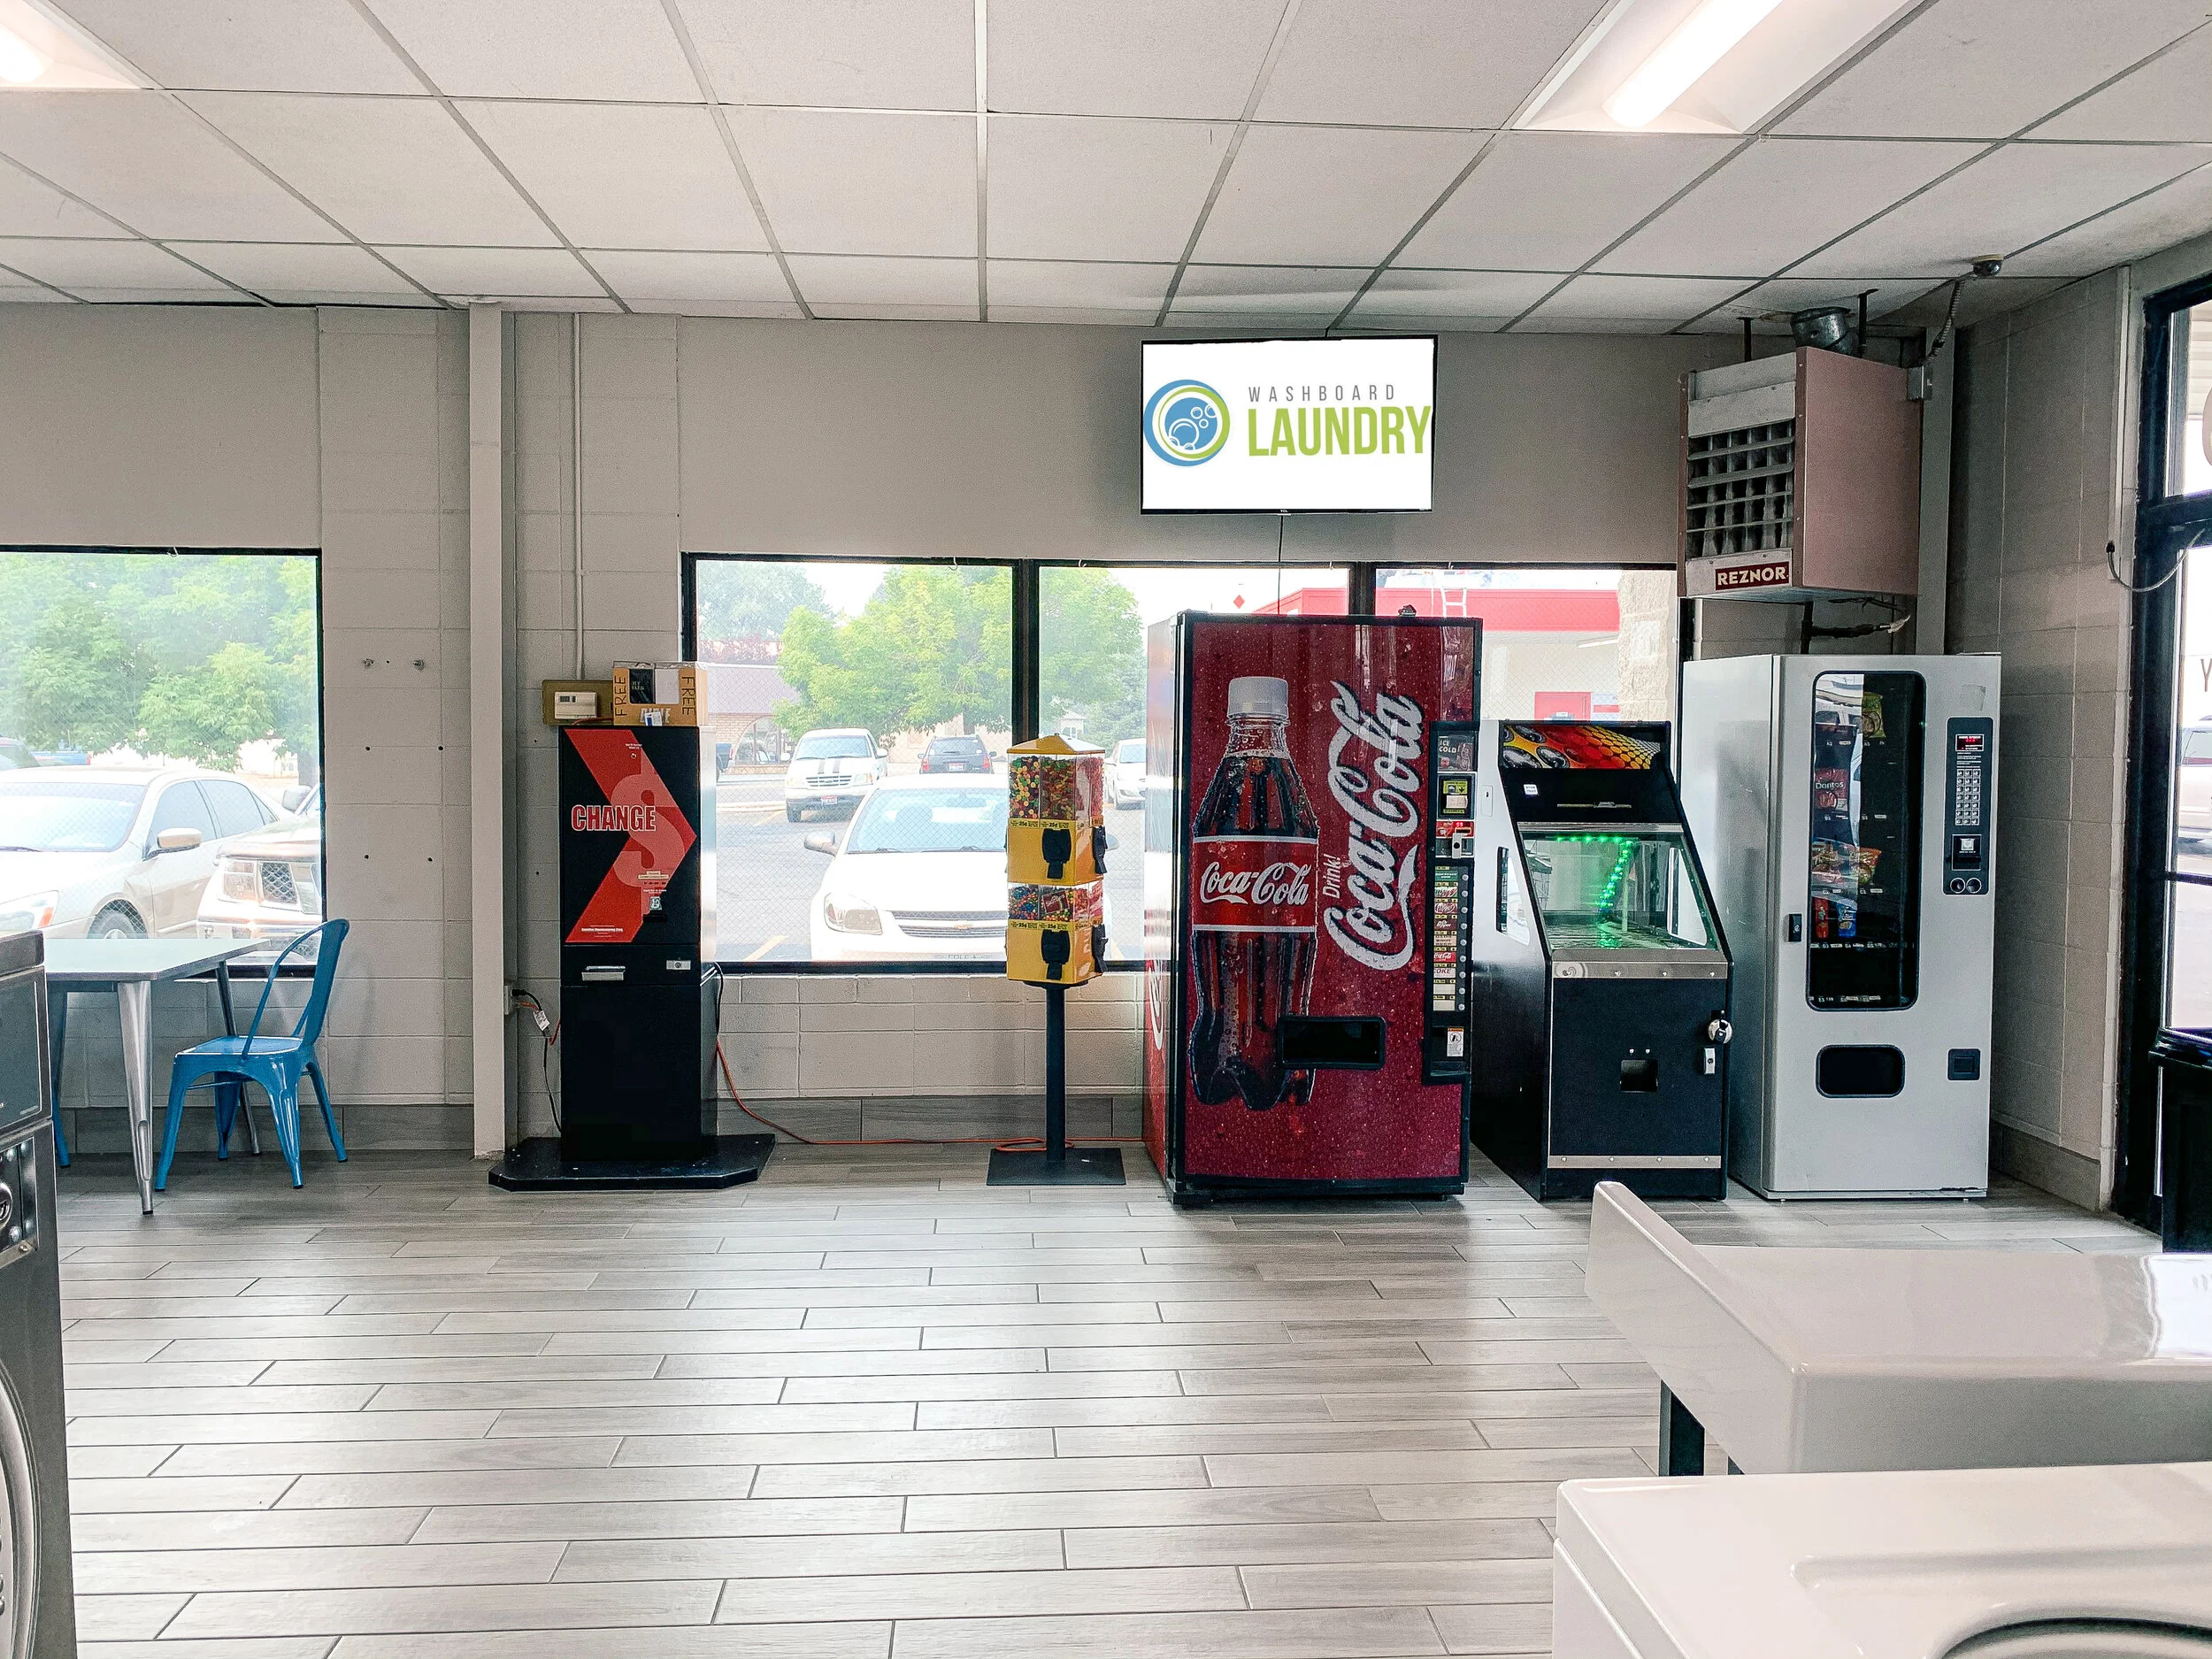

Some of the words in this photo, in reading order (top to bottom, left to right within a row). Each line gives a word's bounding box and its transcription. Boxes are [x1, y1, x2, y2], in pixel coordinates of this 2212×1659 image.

[1248, 384, 1394, 403] WASHBOARD
[1248, 405, 1432, 457] LAUNDRY
[1717, 566, 1787, 586] REZNOR
[614, 675, 627, 717] FREE
[681, 676, 696, 715] FREE
[571, 804, 657, 832] CHANGE
[1324, 680, 1425, 971] Coca-Cola
[1200, 860, 1310, 906] Coca-Cola
[1322, 853, 1341, 899] Drink!
